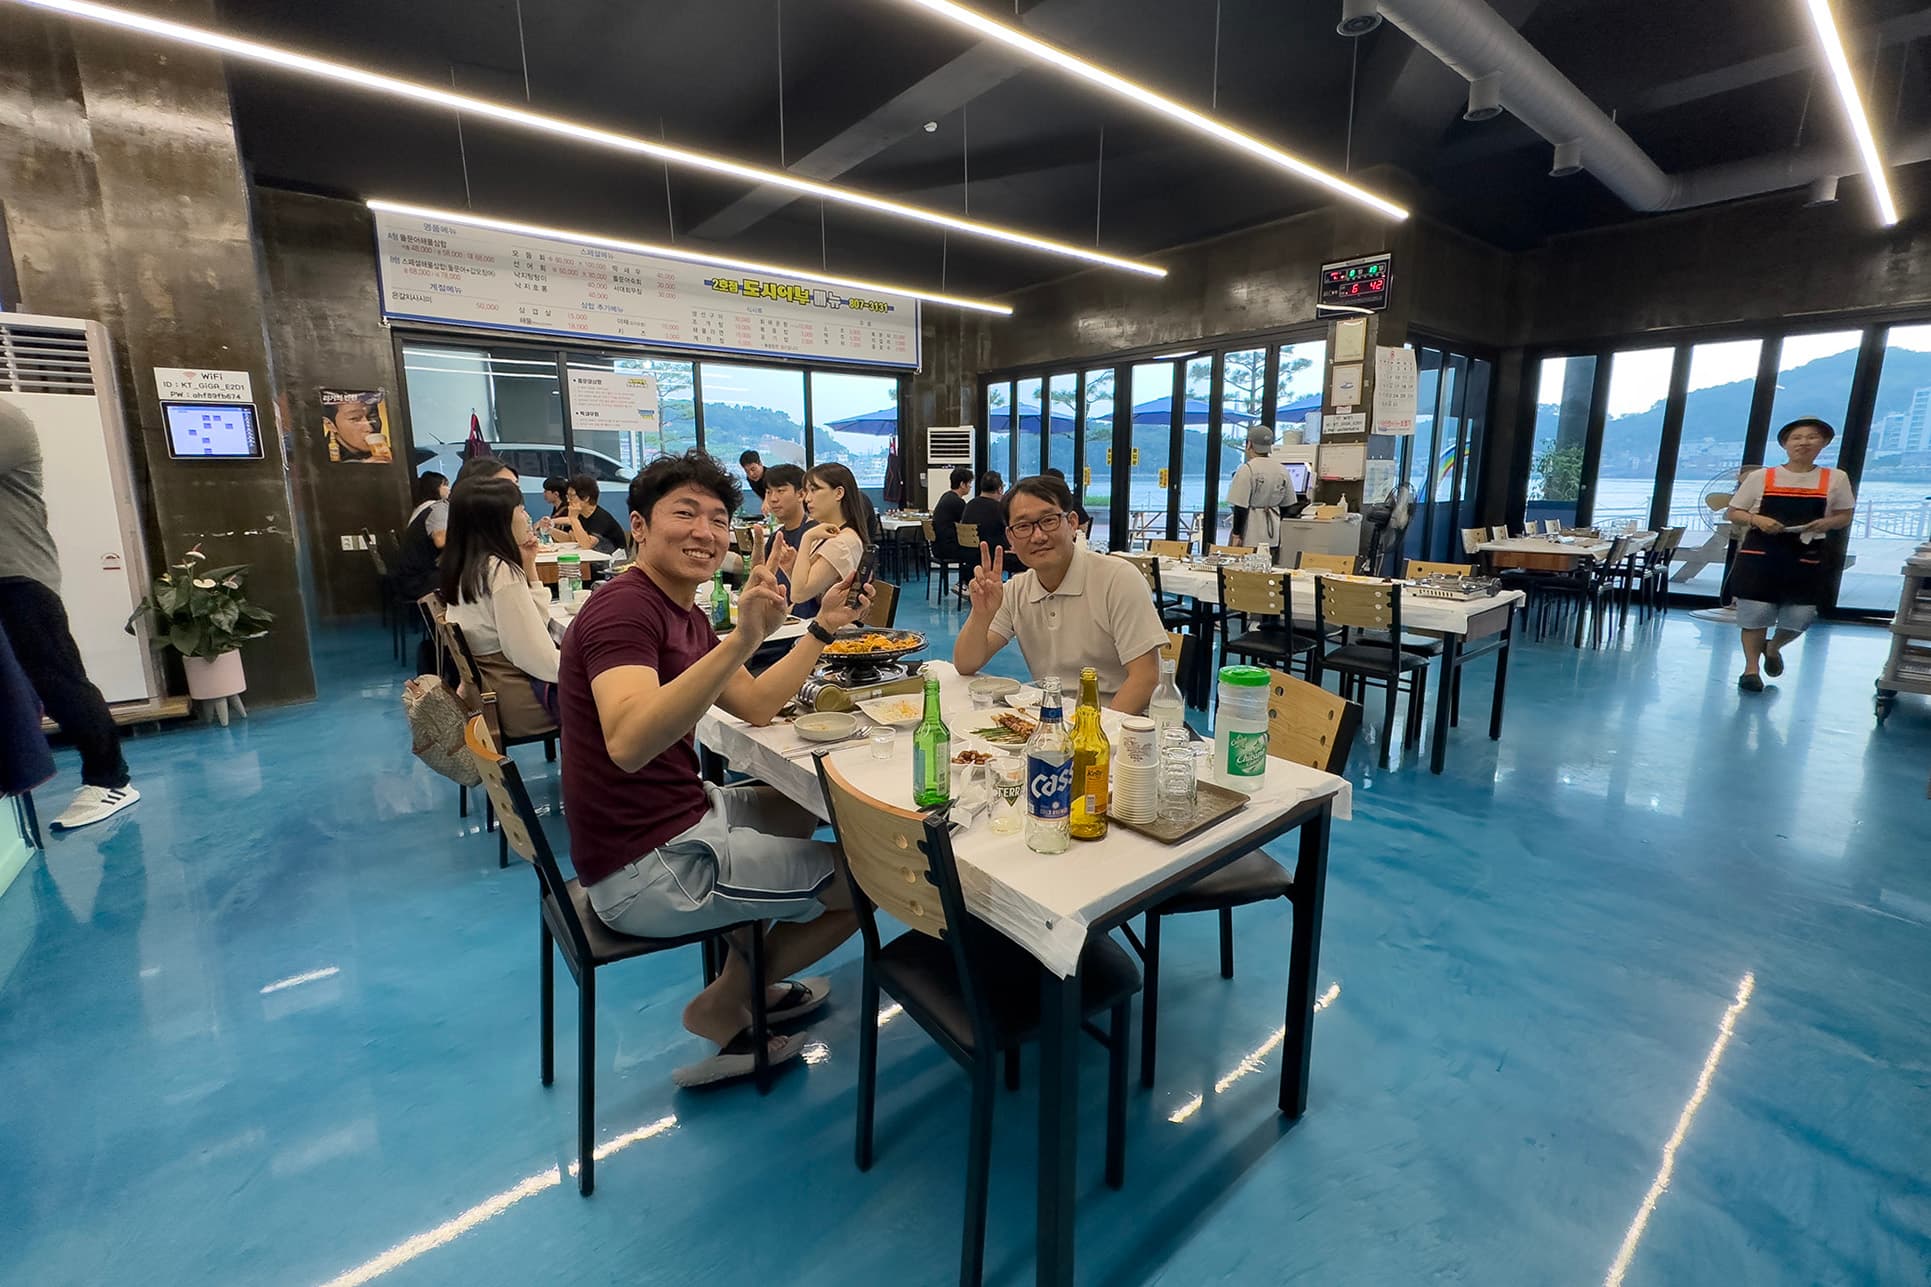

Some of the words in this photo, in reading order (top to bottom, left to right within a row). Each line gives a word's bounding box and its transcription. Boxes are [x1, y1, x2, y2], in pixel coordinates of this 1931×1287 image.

[712, 278, 738, 294] 2호점
[742, 279, 811, 305] 도시어부
[848, 298, 888, 313] 807-3131
[1370, 280, 1383, 290] 42
